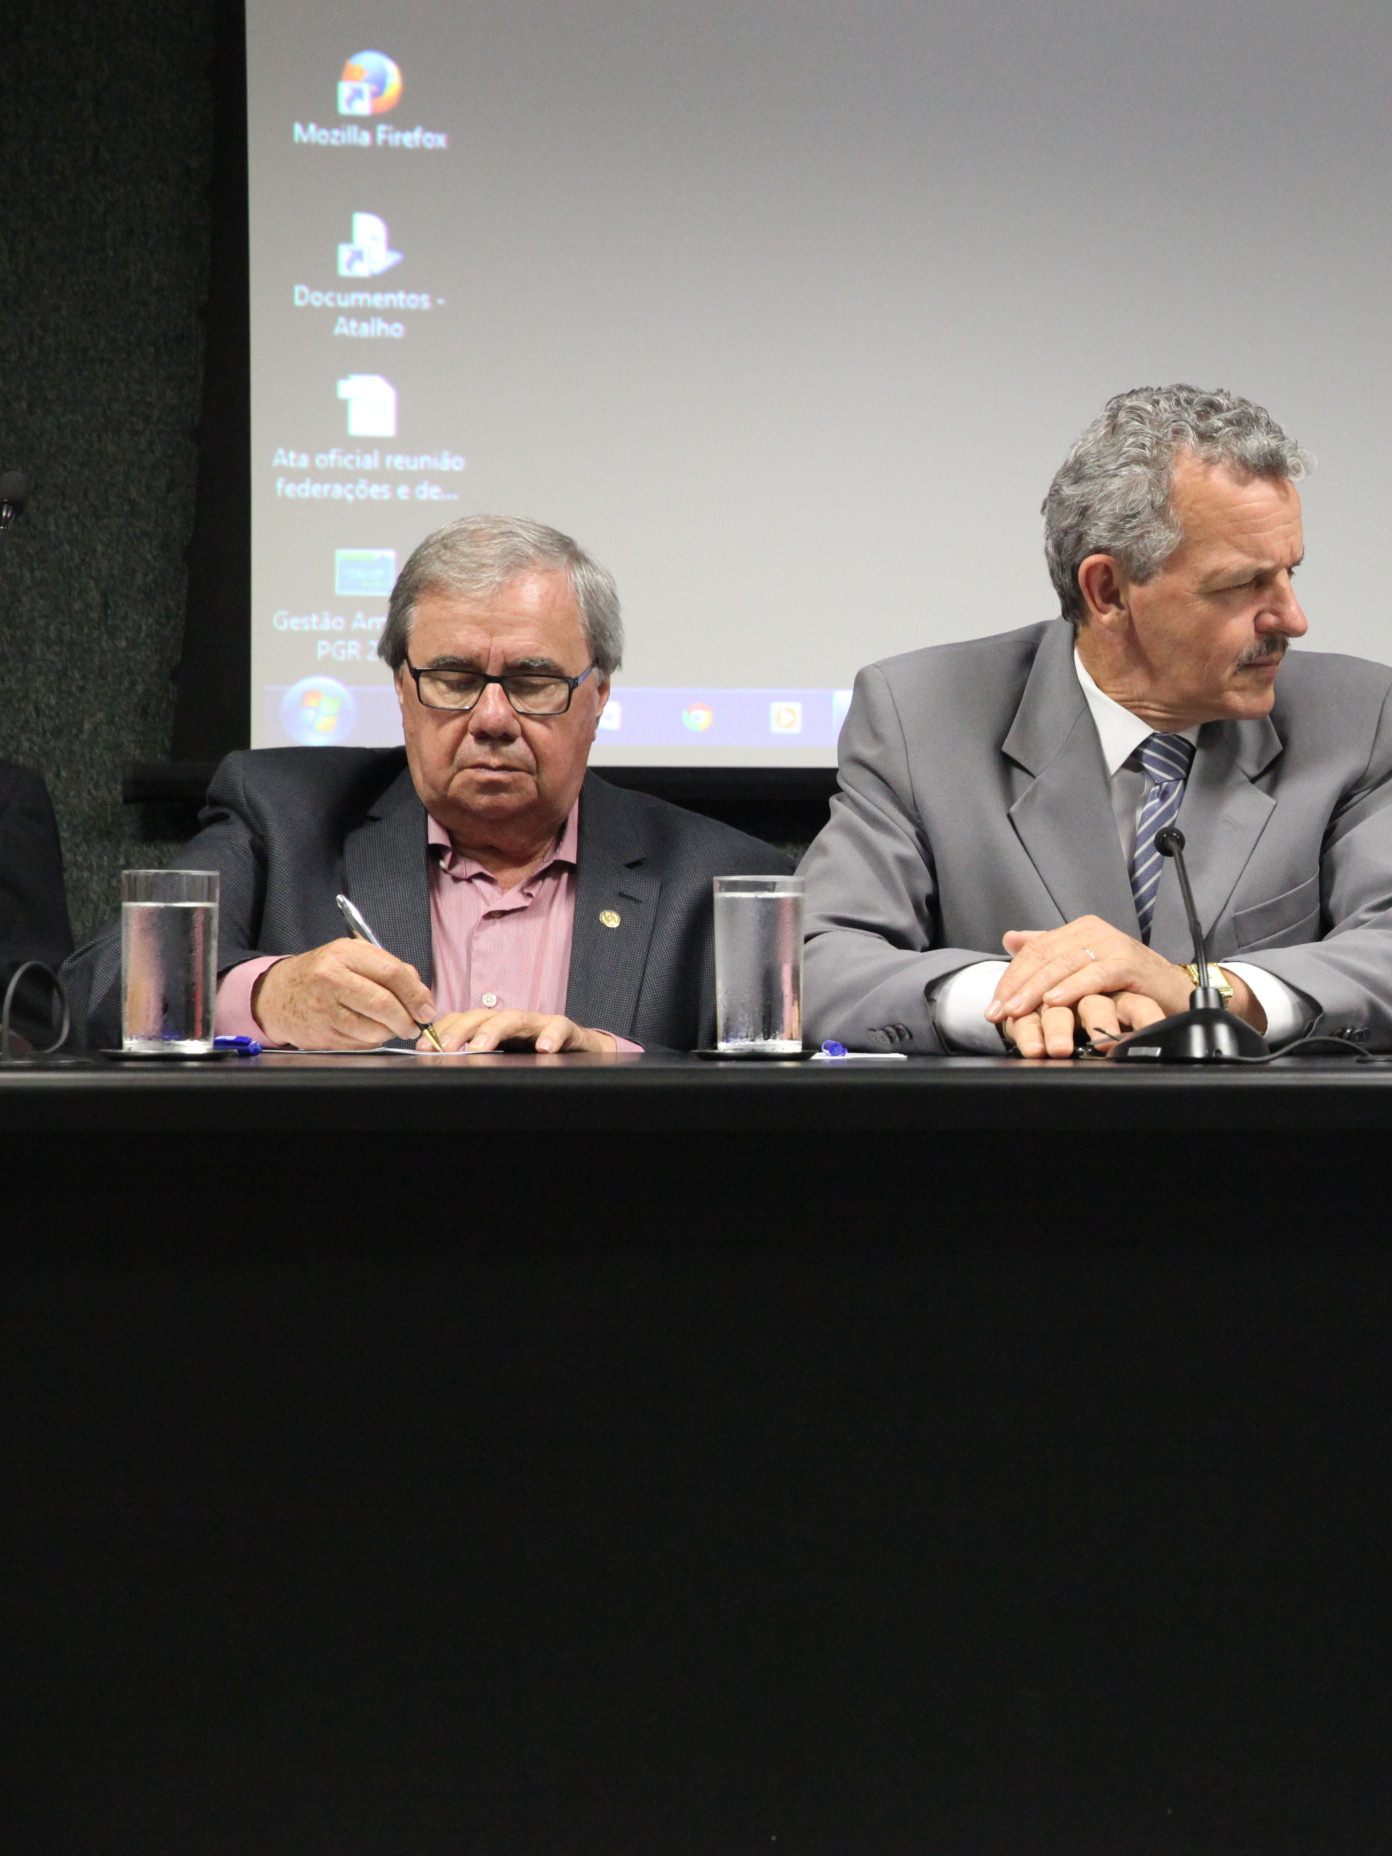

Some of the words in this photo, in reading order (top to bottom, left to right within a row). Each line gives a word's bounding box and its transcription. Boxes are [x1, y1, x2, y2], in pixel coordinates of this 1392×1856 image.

[293, 122, 371, 147] Mozilla
[375, 123, 448, 148] Firefox
[293, 284, 431, 310] Documentos
[332, 315, 405, 339] Atalho
[272, 447, 309, 469] Ata
[315, 448, 379, 471] oficial
[385, 450, 466, 473] reunião
[275, 477, 392, 504] federações
[396, 482, 410, 500] e
[414, 479, 459, 501] de...
[272, 610, 346, 632] Gestão
[316, 640, 362, 661] PGR
